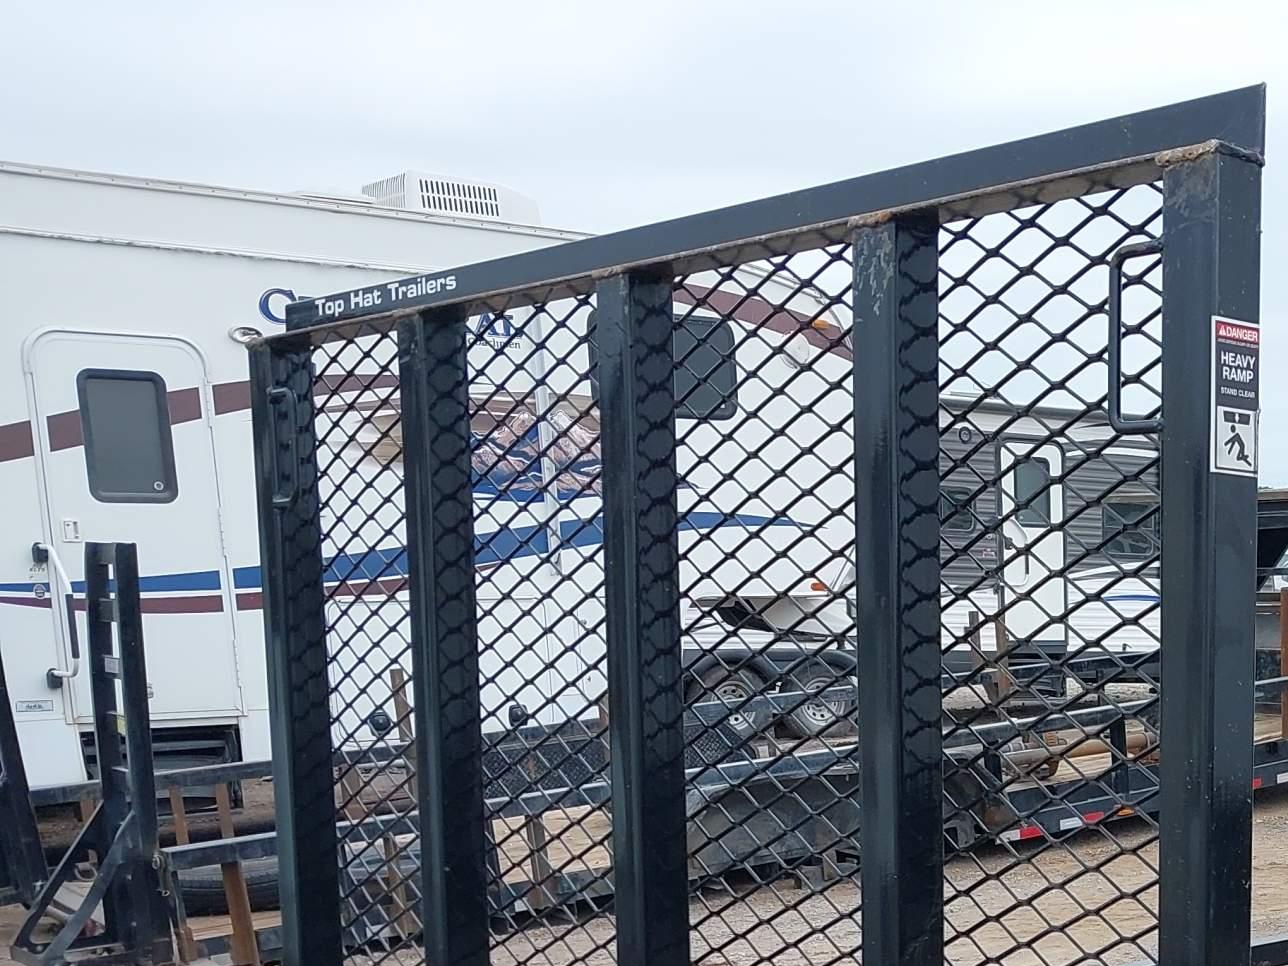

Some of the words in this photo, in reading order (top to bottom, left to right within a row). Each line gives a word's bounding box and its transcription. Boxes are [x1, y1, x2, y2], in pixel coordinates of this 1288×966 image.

[314, 297, 345, 317] Top
[350, 289, 382, 308] Hat
[387, 275, 457, 301] Trailers
[1226, 327, 1258, 341] DANGER
[1221, 351, 1256, 369] HEAVY
[1222, 367, 1254, 383] RAMP
[1220, 387, 1238, 397] STAND
[1238, 390, 1255, 399] CLEAR
